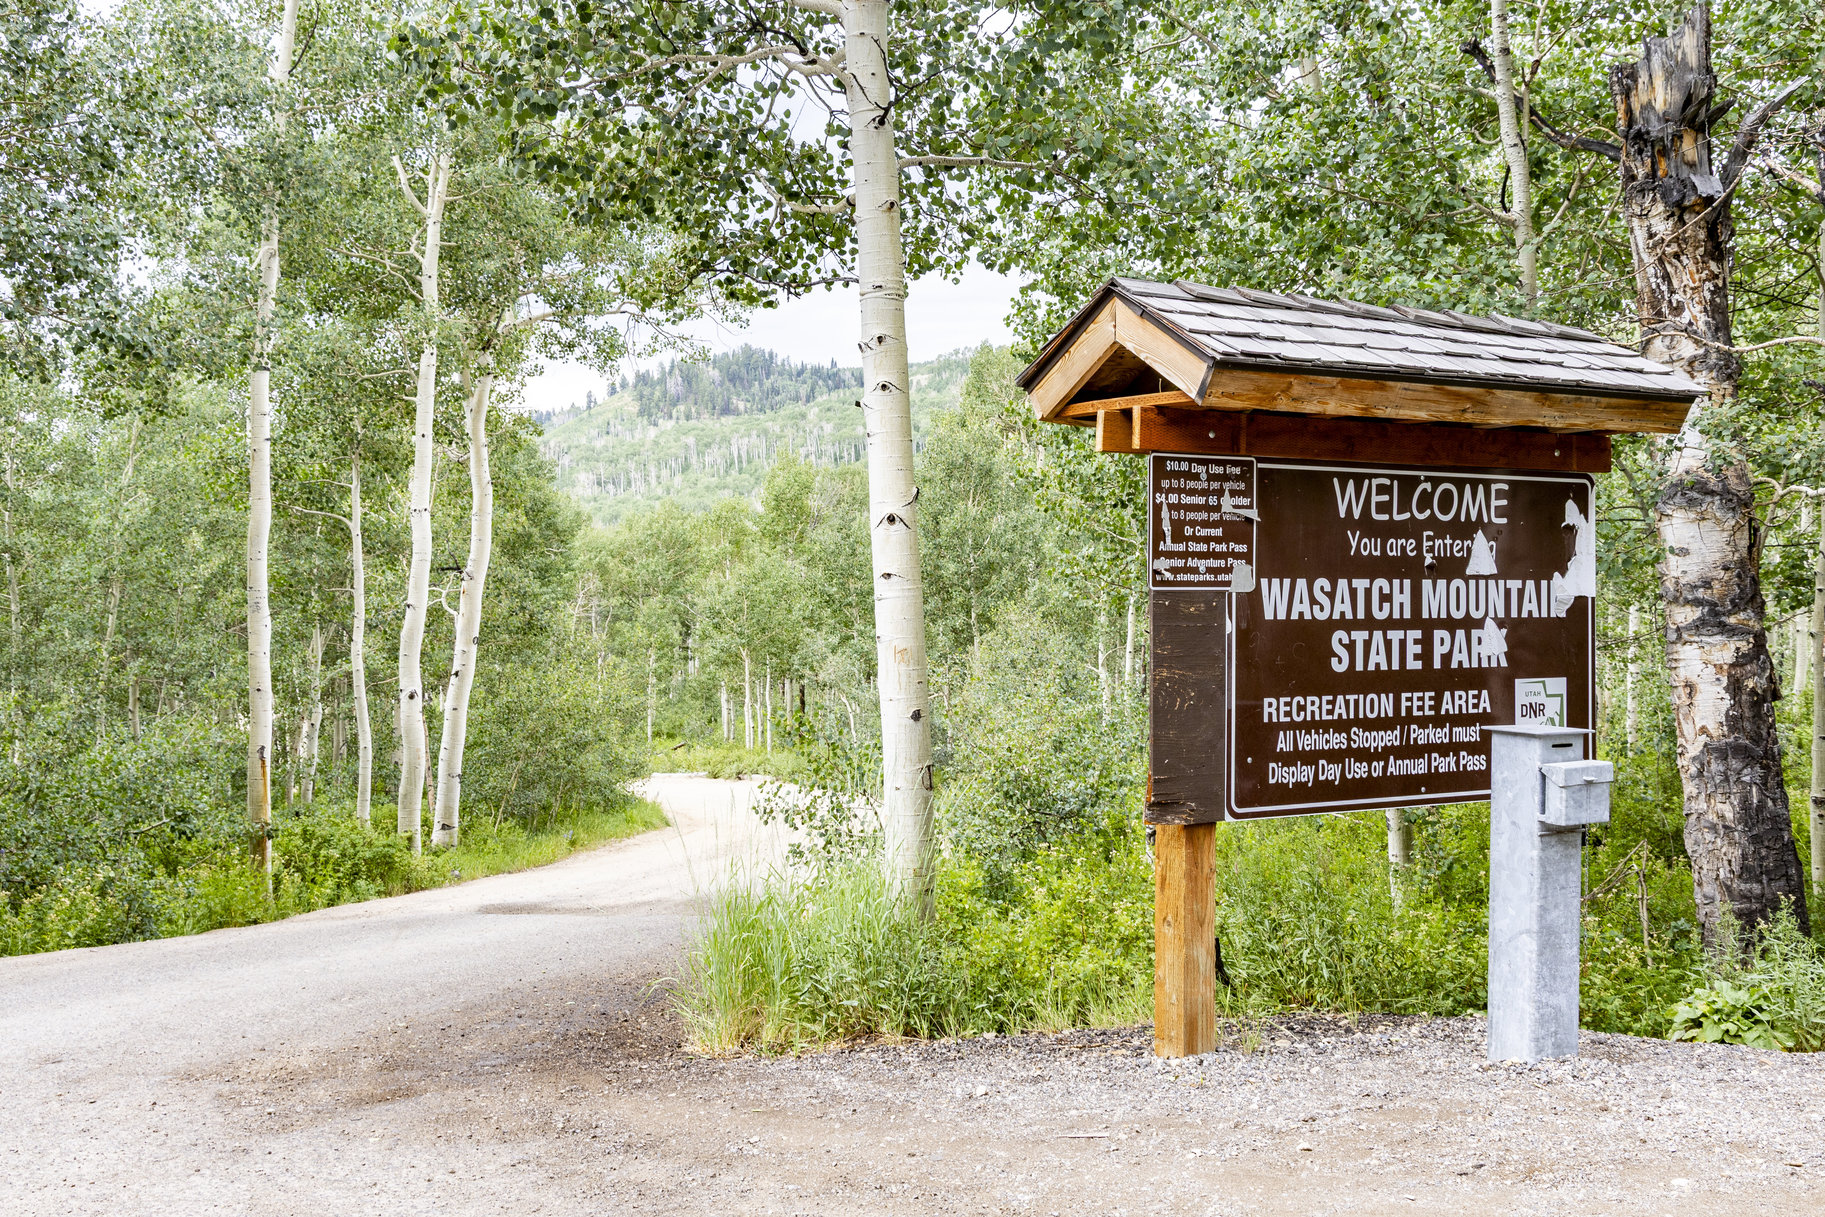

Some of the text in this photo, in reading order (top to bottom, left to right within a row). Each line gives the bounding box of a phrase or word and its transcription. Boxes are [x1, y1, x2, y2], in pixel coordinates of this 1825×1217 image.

[1166, 460, 1189, 471] $10.00
[1191, 463, 1207, 474] Day
[1209, 464, 1224, 474] Use
[1161, 478, 1245, 491] up to 8 people per vehicle
[1155, 493, 1179, 504] $4.00
[1180, 493, 1207, 505] Senior
[1208, 495, 1218, 506] 65
[1333, 477, 1510, 524] WELCOME
[1171, 510, 1178, 519] to
[1179, 509, 1185, 520] 8
[1186, 511, 1208, 522] people
[1209, 512, 1221, 522] per
[1184, 526, 1223, 537] Or Current
[1188, 541, 1208, 552] State
[1209, 542, 1227, 552] Park
[1229, 542, 1248, 553] Pass
[1347, 530, 1380, 556] You
[1387, 539, 1416, 556] are
[1187, 557, 1226, 568] Adventure
[1261, 578, 1410, 620] WASATCH
[1331, 630, 1422, 672] STATE
[1264, 690, 1491, 722] RECREATION FEE AREA
[1520, 701, 1546, 719] DNR
[1277, 723, 1480, 752] All Vehicles Stopped / Parked must
[1269, 751, 1486, 788] Display Day Use or Annual Park Pass
